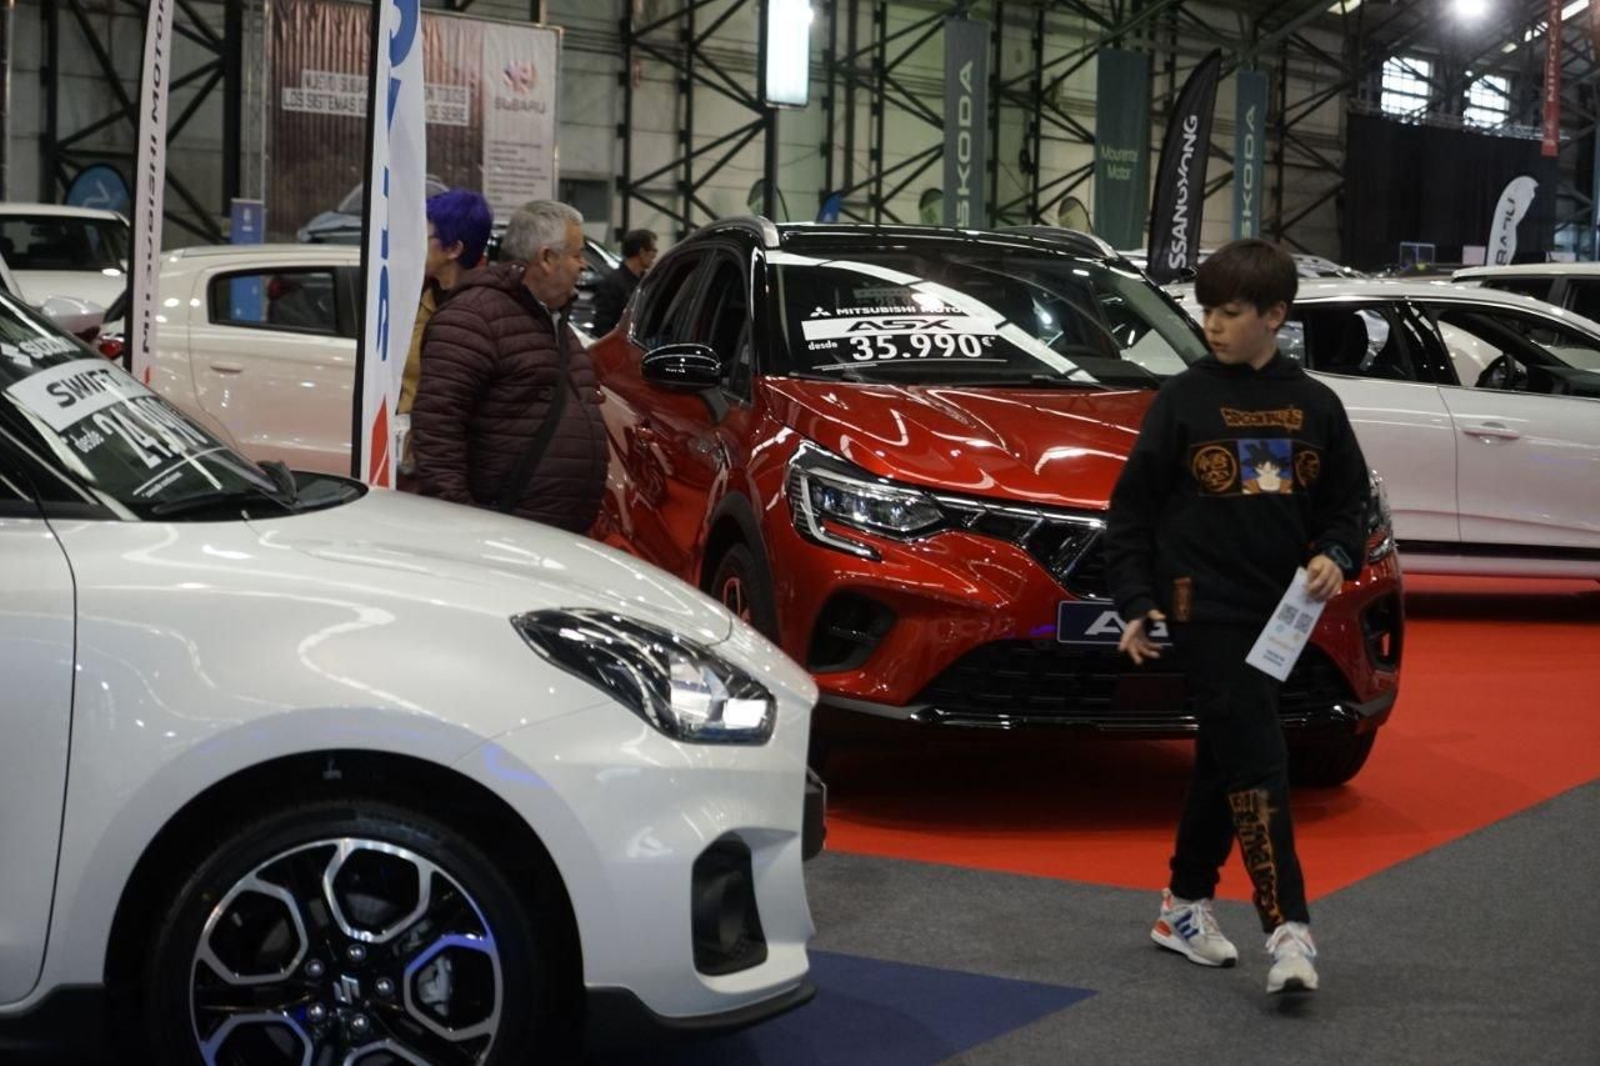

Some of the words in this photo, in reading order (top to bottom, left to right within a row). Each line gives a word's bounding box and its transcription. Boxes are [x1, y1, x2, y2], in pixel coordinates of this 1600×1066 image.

[306, 92, 356, 111] SISTEMAS
[494, 97, 546, 115] SUBARU
[1168, 114, 1198, 269] SSANGYONG
[836, 306, 916, 316] MITSUBISHI
[846, 318, 955, 333] ASX
[808, 340, 838, 351] desde
[46, 369, 122, 408] SWIFT
